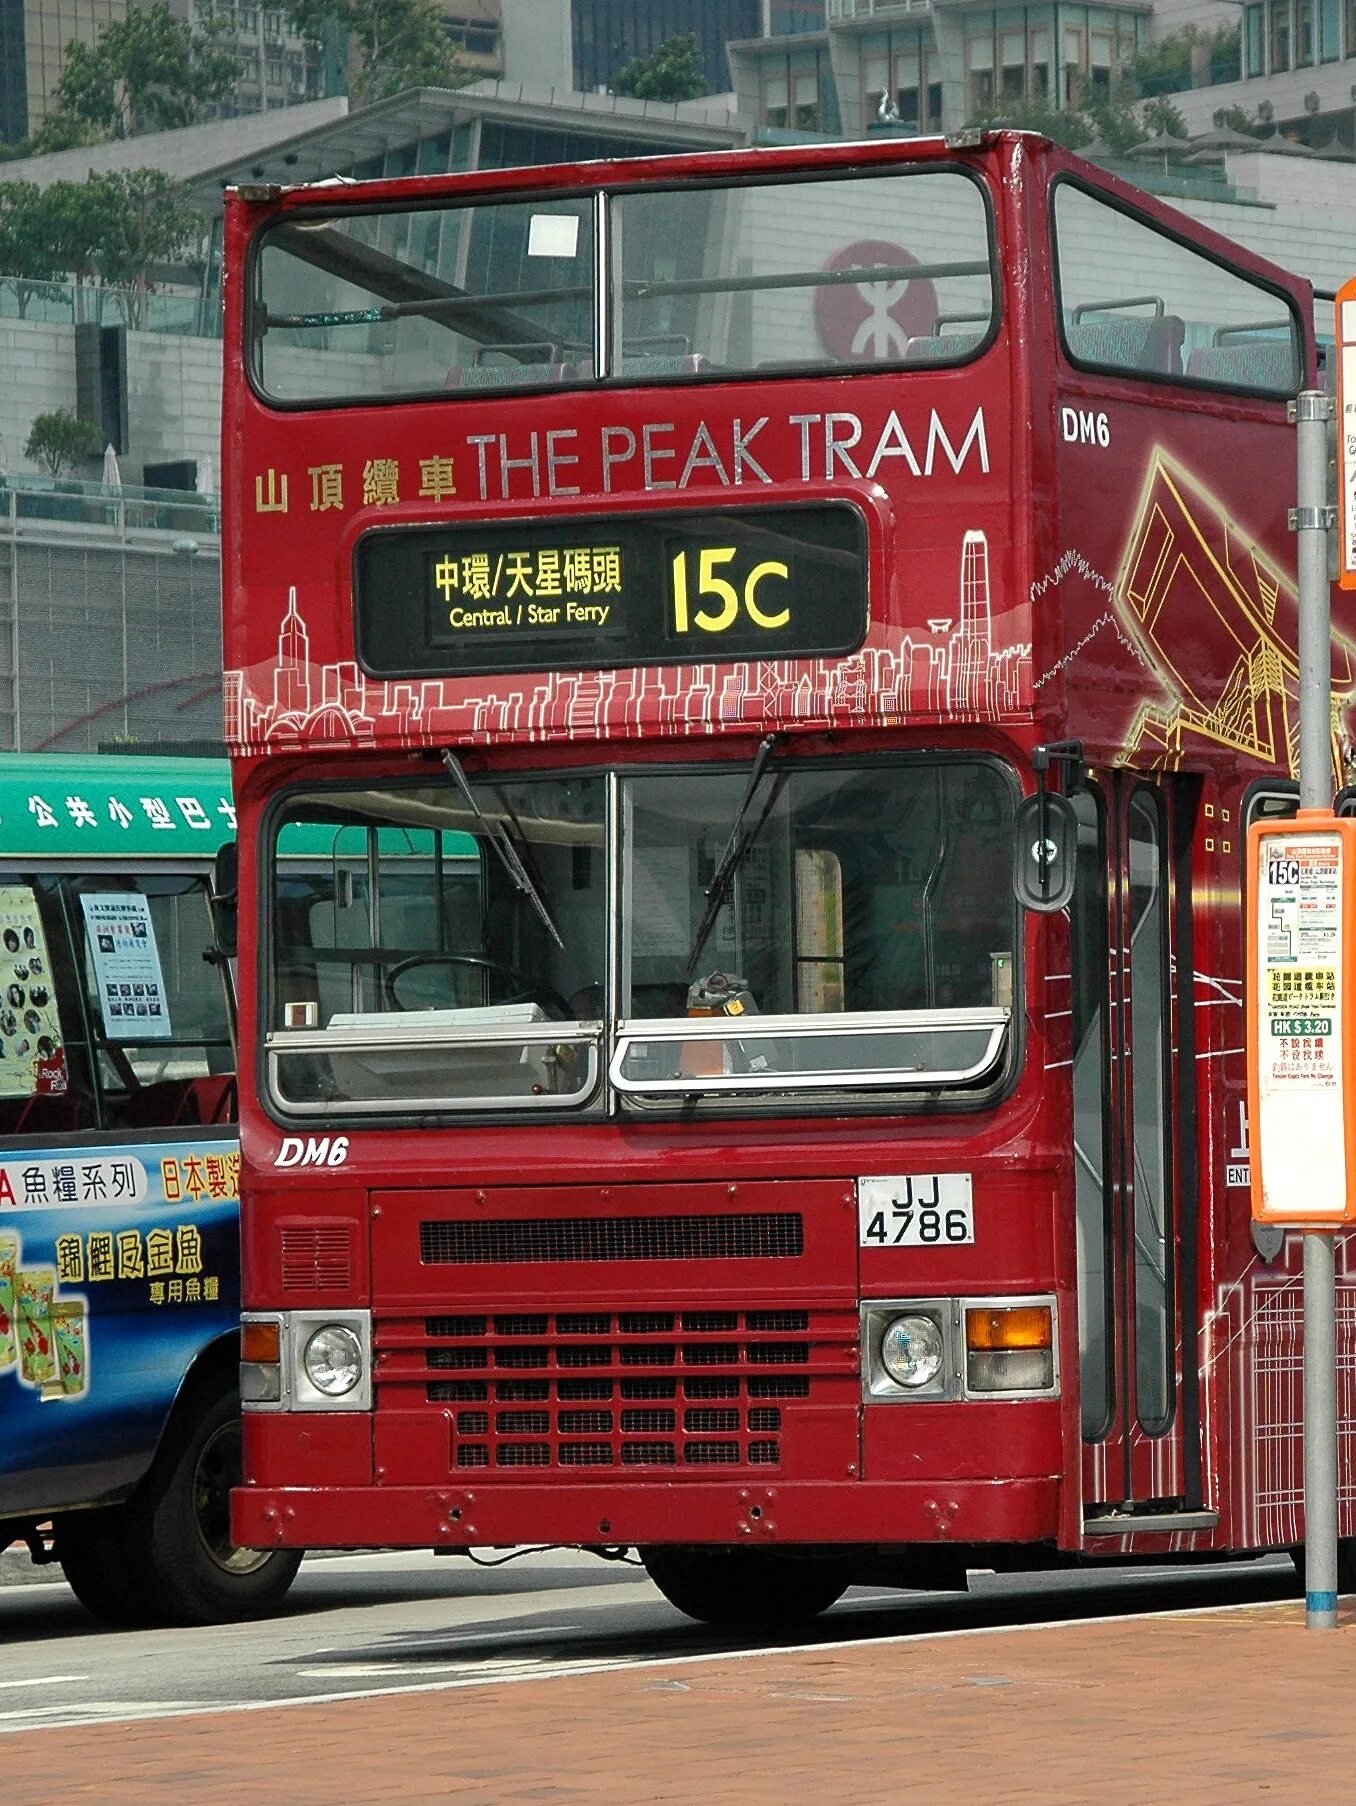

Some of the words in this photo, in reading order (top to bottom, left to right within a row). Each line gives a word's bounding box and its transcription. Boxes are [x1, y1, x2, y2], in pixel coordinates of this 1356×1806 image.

[1062, 407, 1110, 448] DM6
[466, 429, 581, 500] THE
[601, 416, 773, 493] PEAK
[789, 406, 989, 482] TRAM
[255, 455, 457, 513] 山頂纜車
[434, 546, 622, 602] 中環/天星碼頭
[449, 606, 512, 628] Central
[527, 603, 560, 625] Star
[565, 601, 610, 626] Ferry
[1274, 1020, 1292, 1034] HK
[274, 1136, 350, 1168] DM6
[22, 1162, 137, 1204] 魚糧系列
[892, 1176, 940, 1210] JJ
[866, 1209, 967, 1244] 4786
[149, 1276, 219, 1304] 專用魚糧
